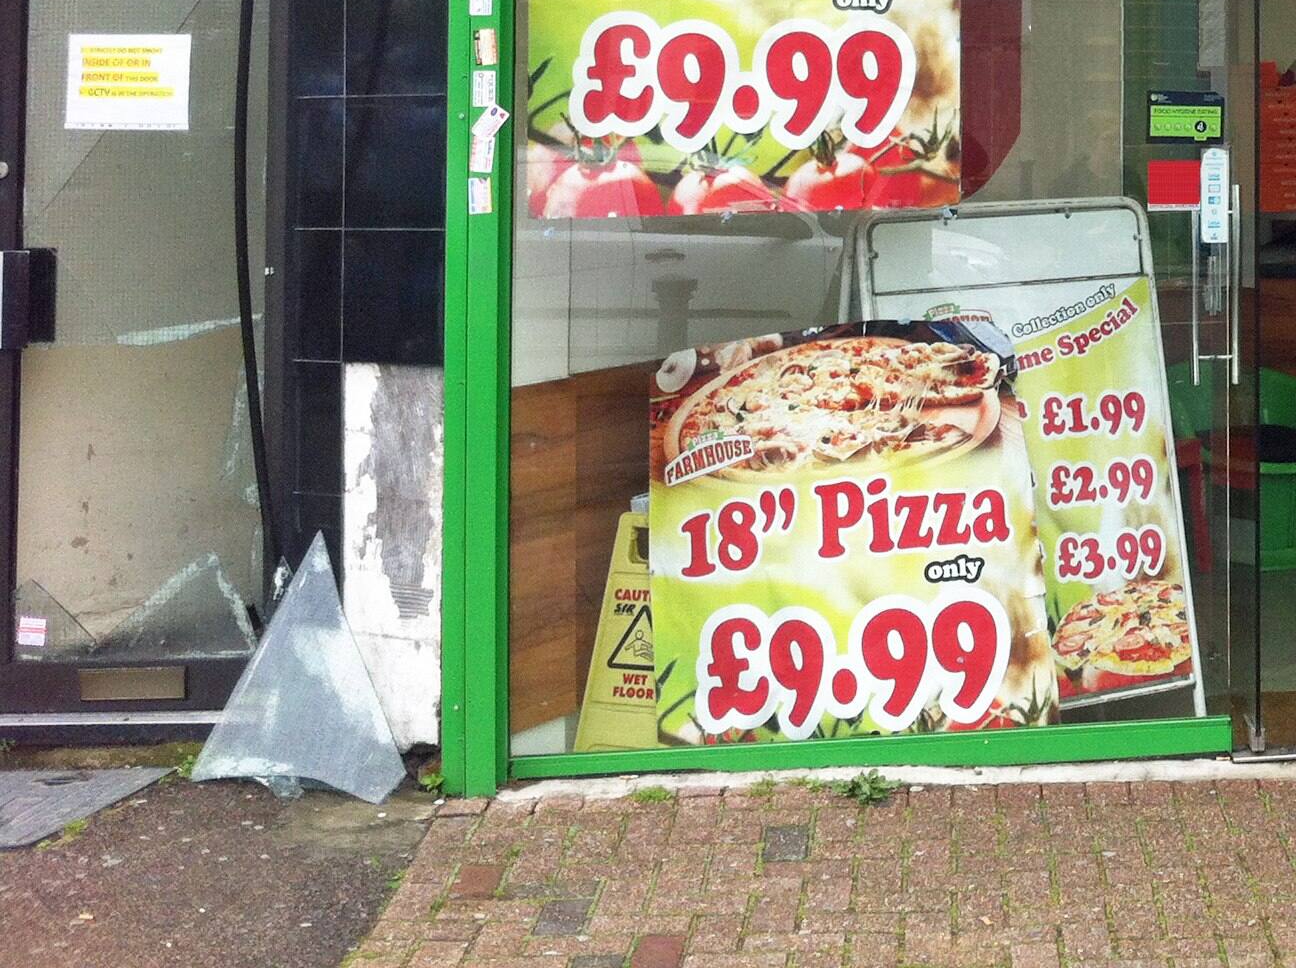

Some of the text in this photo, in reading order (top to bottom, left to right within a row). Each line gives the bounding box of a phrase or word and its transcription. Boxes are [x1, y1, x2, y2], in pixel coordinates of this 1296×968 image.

[582, 23, 904, 141] £9.99
[1011, 283, 1117, 338] Collection only
[1016, 297, 1139, 371] me Special
[1043, 391, 1146, 436] £1.99
[666, 439, 752, 484] FARMHOUSE
[1050, 458, 1154, 506] £2.99
[815, 477, 1010, 561] Pizza
[926, 558, 983, 582] only
[1058, 528, 1162, 580] £3.99
[614, 589, 651, 602] CAUT
[623, 673, 648, 685] WET
[707, 599, 999, 729] £9.99
[612, 686, 654, 700] FLOOR
